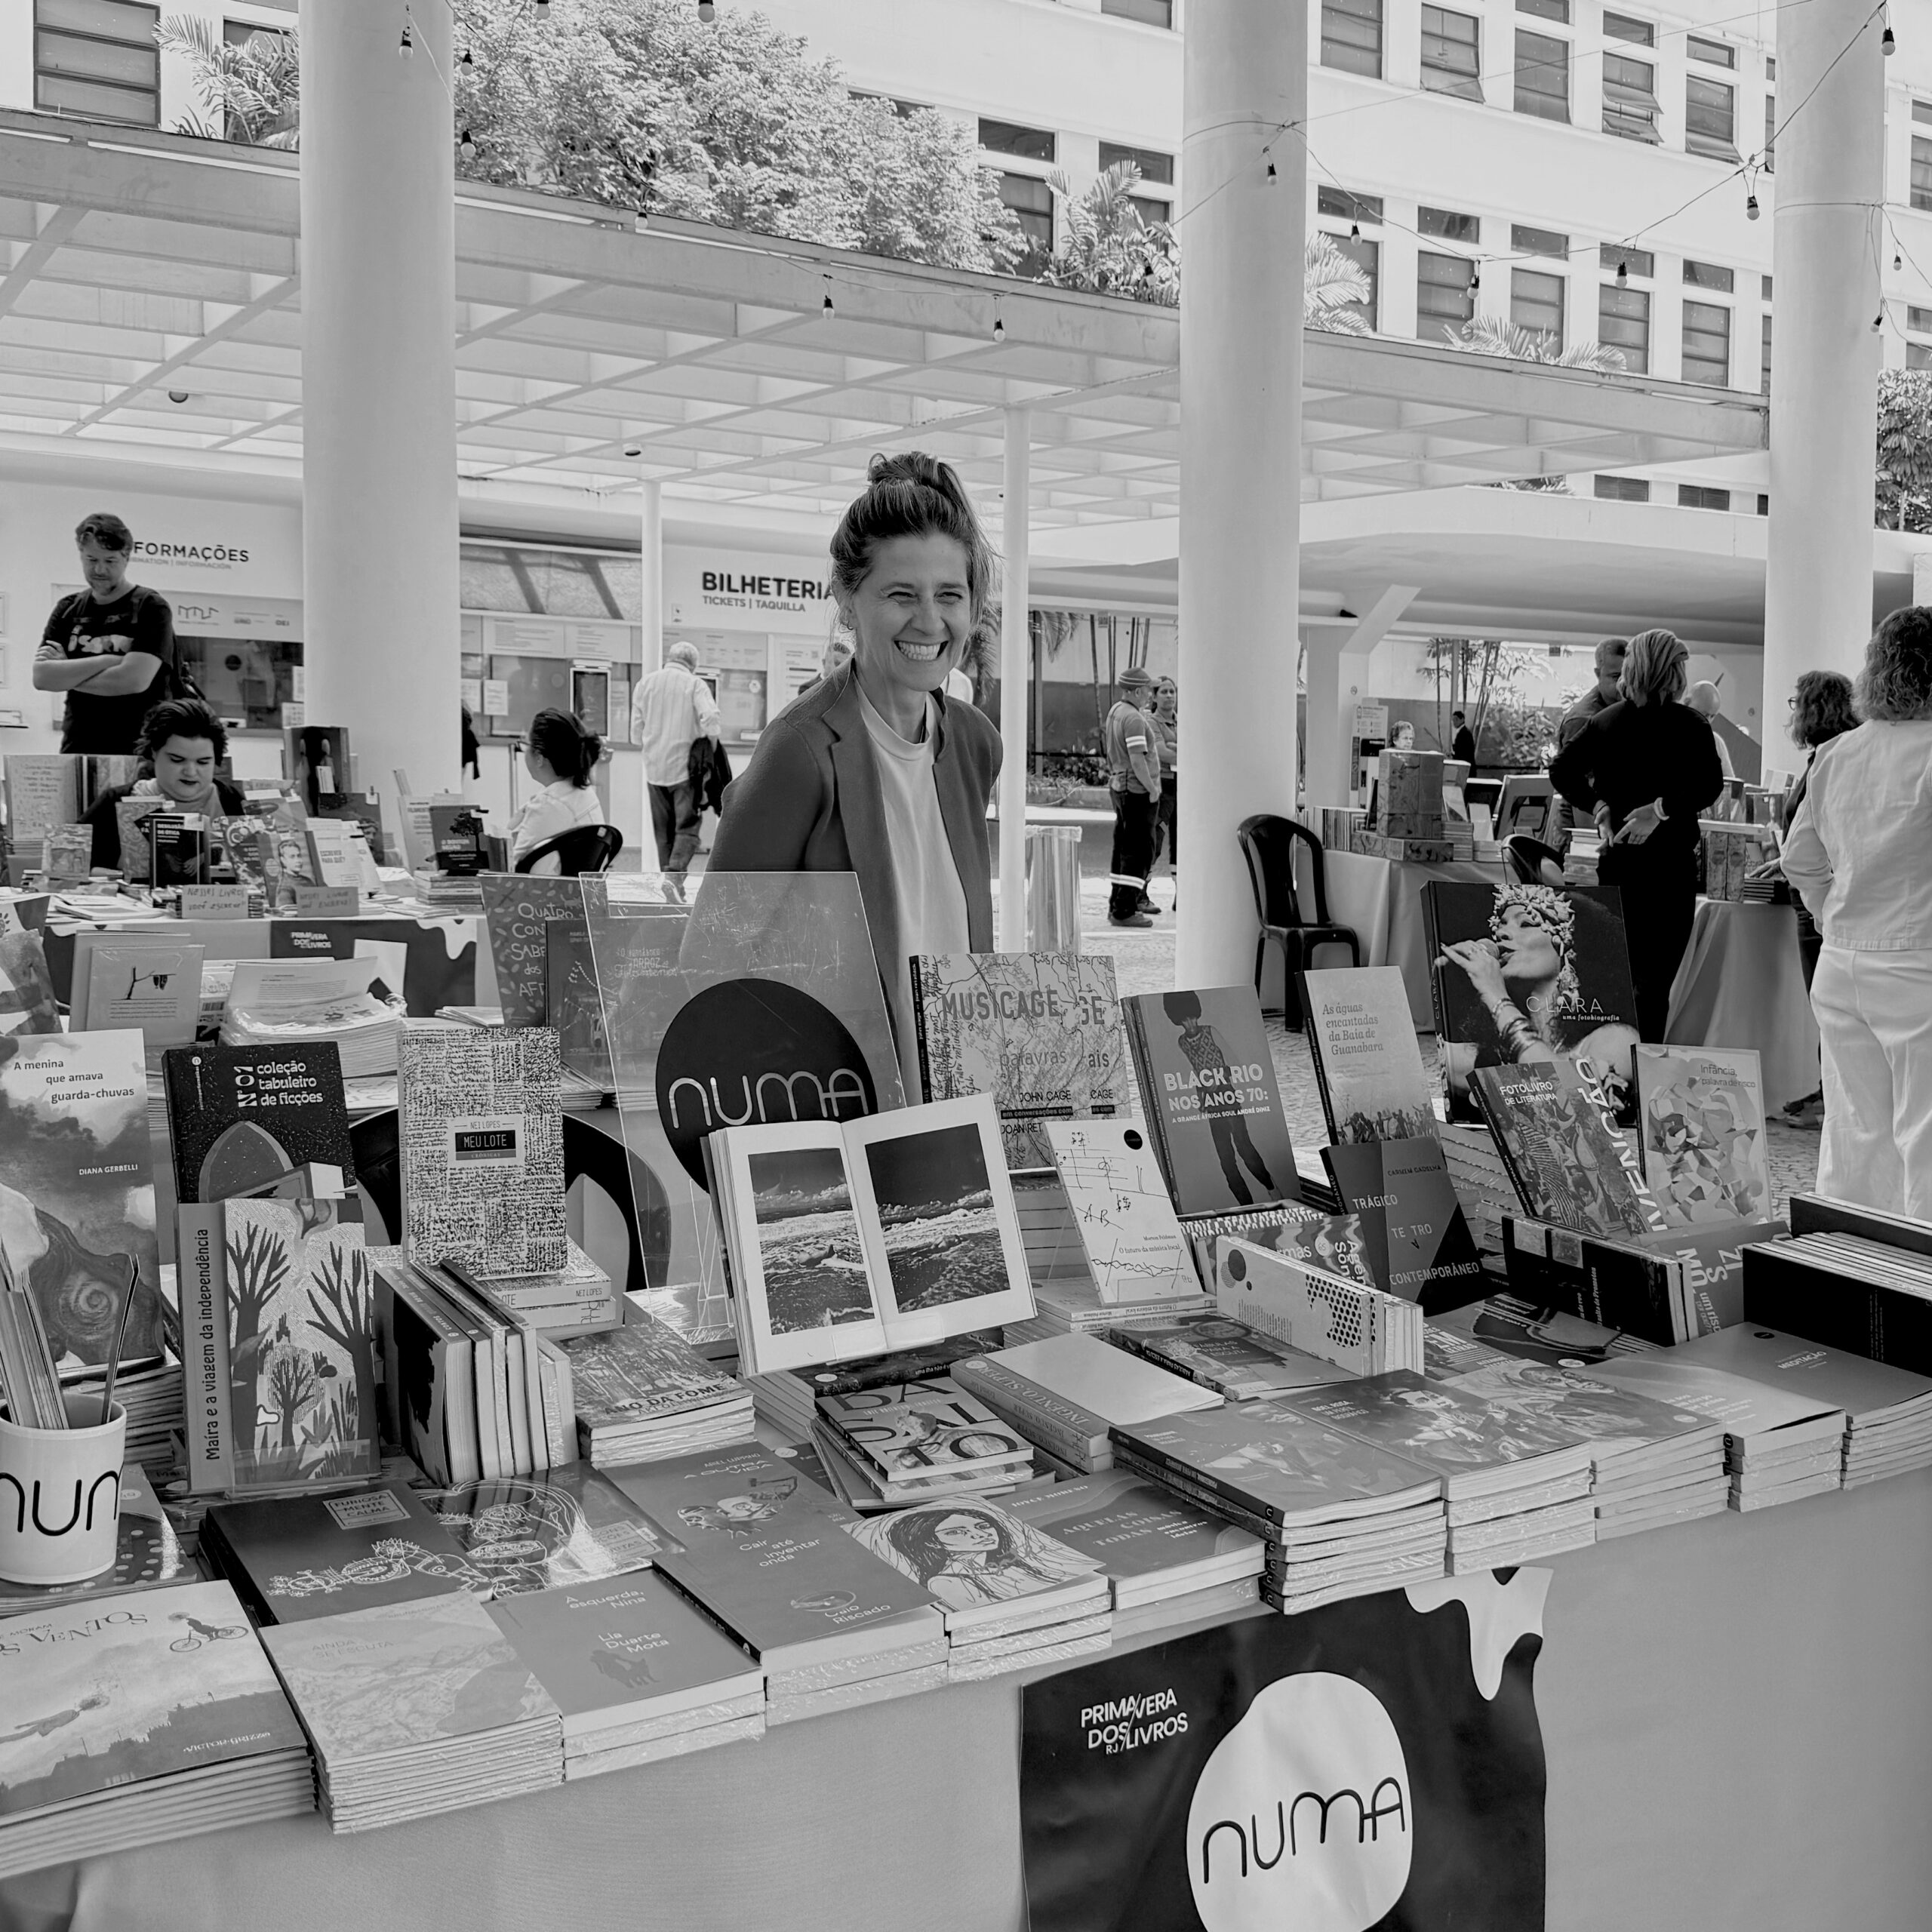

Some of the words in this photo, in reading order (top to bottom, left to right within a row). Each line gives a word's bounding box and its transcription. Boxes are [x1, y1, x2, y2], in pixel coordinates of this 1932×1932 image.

[134, 541, 250, 562] FORMAÇÕES
[703, 595, 746, 608] TICKETS
[755, 599, 805, 612] TAQUILLA
[518, 902, 574, 920] QUATRO
[512, 923, 546, 938] CON
[524, 962, 542, 975] dos
[943, 990, 1066, 1020] MUSICAGE
[1322, 1004, 1334, 1015] As
[1336, 1002, 1363, 1015] águas
[1526, 995, 1604, 1013] CLARA
[1326, 1014, 1378, 1028] encantadas
[1577, 1014, 1620, 1022] fotobiografia
[1329, 1030, 1340, 1041] da
[1365, 1028, 1376, 1038] de
[1331, 1042, 1383, 1055] Guanabara
[14, 1062, 22, 1071] A
[24, 1059, 64, 1070] menina
[999, 1051, 1067, 1067] palavras
[257, 1060, 306, 1075] coleção
[45, 1075, 66, 1085] que
[69, 1072, 103, 1081] amava
[258, 1075, 317, 1090] tabuleiro
[1164, 1067, 1227, 1091] BLACK
[1229, 1063, 1263, 1084] RIO
[51, 1088, 134, 1104] guarda-chuvas
[1091, 1089, 1114, 1100] CAGE
[1500, 1081, 1554, 1097] FOTOLIVRO
[260, 1093, 277, 1106] de
[279, 1091, 324, 1106] ficções
[1020, 1092, 1044, 1103] JOHN
[1046, 1091, 1072, 1101] CAGE
[1168, 1095, 1201, 1112] NOS
[1204, 1090, 1245, 1108] ANOS
[1247, 1088, 1269, 1102] 70:
[1505, 1097, 1516, 1106] DE
[1517, 1093, 1558, 1104] LITERATURA
[1014, 1107, 1057, 1117] conversações
[1177, 1115, 1201, 1123] GRANDE
[1201, 1112, 1221, 1121] ÁFRICA
[1237, 1106, 1255, 1115] ANDRÉ
[1256, 1106, 1271, 1114] DINIZ
[482, 1121, 501, 1129] LOPES
[1001, 1124, 1025, 1134] JOAN
[463, 1135, 481, 1148] MEU
[485, 1134, 508, 1148] LOTE
[78, 1168, 103, 1176] DIANA
[104, 1164, 138, 1173] GERBELLI
[1414, 1164, 1441, 1174] GADELHA
[1352, 1194, 1398, 1210] TRÁGICO
[1391, 1226, 1406, 1238] TE
[1411, 1223, 1432, 1235] TRO
[1149, 1244, 1167, 1253] música
[195, 1228, 212, 1322] independência
[1389, 1262, 1480, 1285] CONTEMPORÂNEO
[502, 1294, 516, 1306] OTE
[586, 1288, 603, 1297] LOPES
[199, 1324, 214, 1340] da
[199, 1344, 217, 1393] viagem
[206, 1396, 217, 1405] a
[605, 1401, 643, 1415] ANO
[647, 1395, 672, 1407] DA
[678, 1383, 727, 1399] FOME
[208, 1407, 218, 1416] e
[204, 1419, 220, 1461] Maíra
[700, 1460, 769, 1476] OUTRA
[730, 1463, 774, 1474] VIDA
[334, 1494, 388, 1508] FURIOSA
[1011, 1497, 1043, 1508] JOYCE
[1044, 1484, 1089, 1500] MORENO
[347, 1506, 391, 1517] CALMA
[1120, 1509, 1183, 1529] COISAS
[1063, 1510, 1138, 1535] AQUELAS
[1094, 1528, 1153, 1546] TODAS
[740, 1540, 768, 1551] Cair
[771, 1539, 794, 1549] até
[764, 1538, 821, 1559] inventar
[759, 1554, 795, 1567] onda
[566, 1595, 578, 1604] A
[569, 1590, 645, 1609] esquerda,
[610, 1596, 647, 1609] Nina
[824, 1604, 860, 1617] Caio
[832, 1604, 891, 1624] Riscado
[27, 1611, 149, 1643] VENTOS
[598, 1632, 623, 1641] Lia
[605, 1632, 662, 1649] Duarte
[312, 1639, 355, 1652] AINDA
[337, 1641, 395, 1657] ESCUTA
[626, 1639, 670, 1654] Mota
[1080, 1687, 1178, 1728] PRIMAVERA
[1088, 1721, 1130, 1750] DOS
[1125, 1712, 1189, 1750] LIVROS
[1106, 1742, 1120, 1755] RJ
